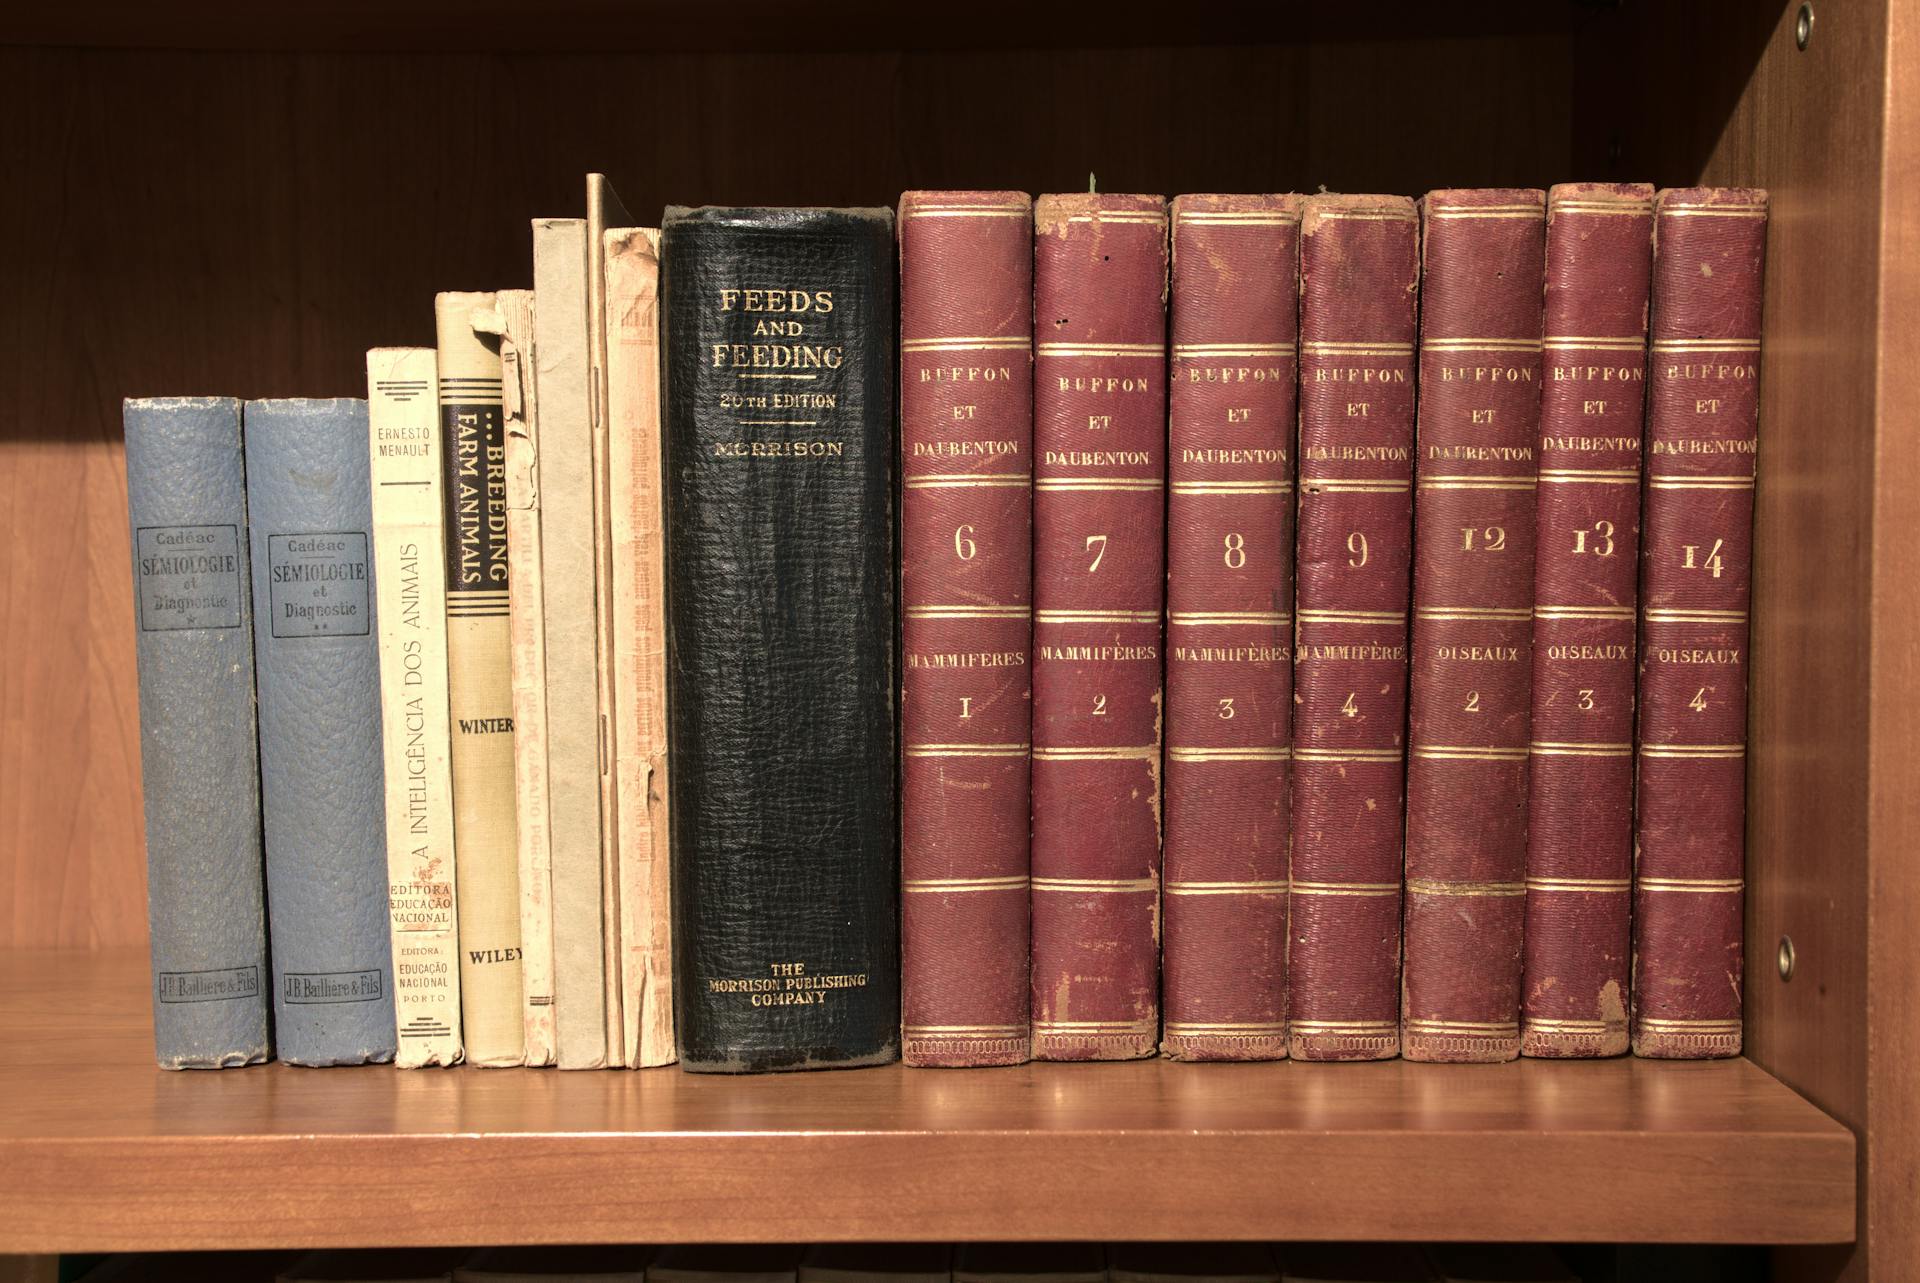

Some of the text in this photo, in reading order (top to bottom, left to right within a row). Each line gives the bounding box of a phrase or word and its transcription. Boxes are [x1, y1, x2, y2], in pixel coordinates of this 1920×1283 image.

[719, 289, 833, 313] FEEDS
[753, 320, 803, 337] AND
[712, 344, 843, 369] FEEDING
[920, 367, 1010, 382] BUFFON
[1190, 367, 1280, 384] BUFFON
[1316, 368, 1405, 383] BUFFON
[1442, 367, 1531, 382] BUFFON
[1554, 366, 1642, 381] BUFFON
[1667, 364, 1756, 379] BUFFON
[1059, 377, 1147, 393] BUFFON
[773, 394, 836, 408] EDITION
[1584, 400, 1607, 415] ET
[1696, 399, 1720, 413] ET
[953, 405, 977, 420] ET
[1228, 408, 1251, 422] ET
[1347, 403, 1370, 417] ET
[1472, 409, 1496, 423] ET
[1088, 415, 1112, 430] ET
[378, 427, 430, 440] ERNESTO
[379, 444, 431, 457] MENAULT
[714, 441, 843, 457] MORRISON
[914, 441, 1018, 456] DAUBENTON
[1543, 437, 1640, 451] DAUBENTO
[1653, 439, 1757, 455] DAUBENTON
[1046, 451, 1150, 466] DAUBENTON
[1183, 449, 1287, 463] DAUBENTON
[1429, 445, 1532, 461] DAUBENTON
[458, 414, 481, 583] FARM ANIMALS
[487, 445, 508, 582] BREEDING
[156, 532, 215, 545] Cadéac
[288, 539, 346, 552] Cadéac
[955, 524, 977, 560] 6
[1461, 527, 1505, 551] 12
[1572, 521, 1614, 556] 13
[1086, 535, 1107, 572] 7
[1224, 533, 1246, 568] 8
[1347, 532, 1368, 567] 9
[142, 553, 235, 576] SÉMIOLOGIE
[1681, 538, 1724, 578] 14
[273, 561, 365, 583] SÉMIOLOGIE
[183, 577, 197, 590] et
[312, 586, 327, 598] et
[284, 601, 357, 621] Diagnostic
[1041, 642, 1157, 660] MAMMIFÈRES
[1175, 642, 1290, 662] MAMMIFÈRES
[1297, 640, 1404, 660] MAMMIFÈRE
[1439, 647, 1519, 661] OISEAUX
[1548, 645, 1628, 659] OISEAUX
[1659, 650, 1739, 664] OISEAUX
[399, 543, 428, 859] A INTELIGÊNCIA DOS ANIMAIS
[1092, 693, 1106, 715] 2
[1342, 692, 1358, 717] 4
[1465, 691, 1480, 712] 2
[1578, 689, 1594, 710] 3
[1689, 688, 1706, 711] 4
[1219, 698, 1234, 719] 3
[391, 885, 450, 895] EDITORA
[390, 897, 451, 910] EDUCAÇÃO
[393, 913, 448, 923] NACIONAL
[469, 948, 522, 964] WILEY
[400, 962, 448, 975] EDUCAÇÃO
[771, 963, 805, 976] THE
[228, 979, 236, 992] &
[237, 971, 256, 992] Fils
[303, 978, 350, 998] Baillière
[352, 981, 359, 995] &
[361, 975, 379, 994] Fils
[400, 979, 448, 988] NACIONAL
[709, 974, 866, 993] MORRISON PUBLISHING
[751, 991, 826, 1006] COMPANY
